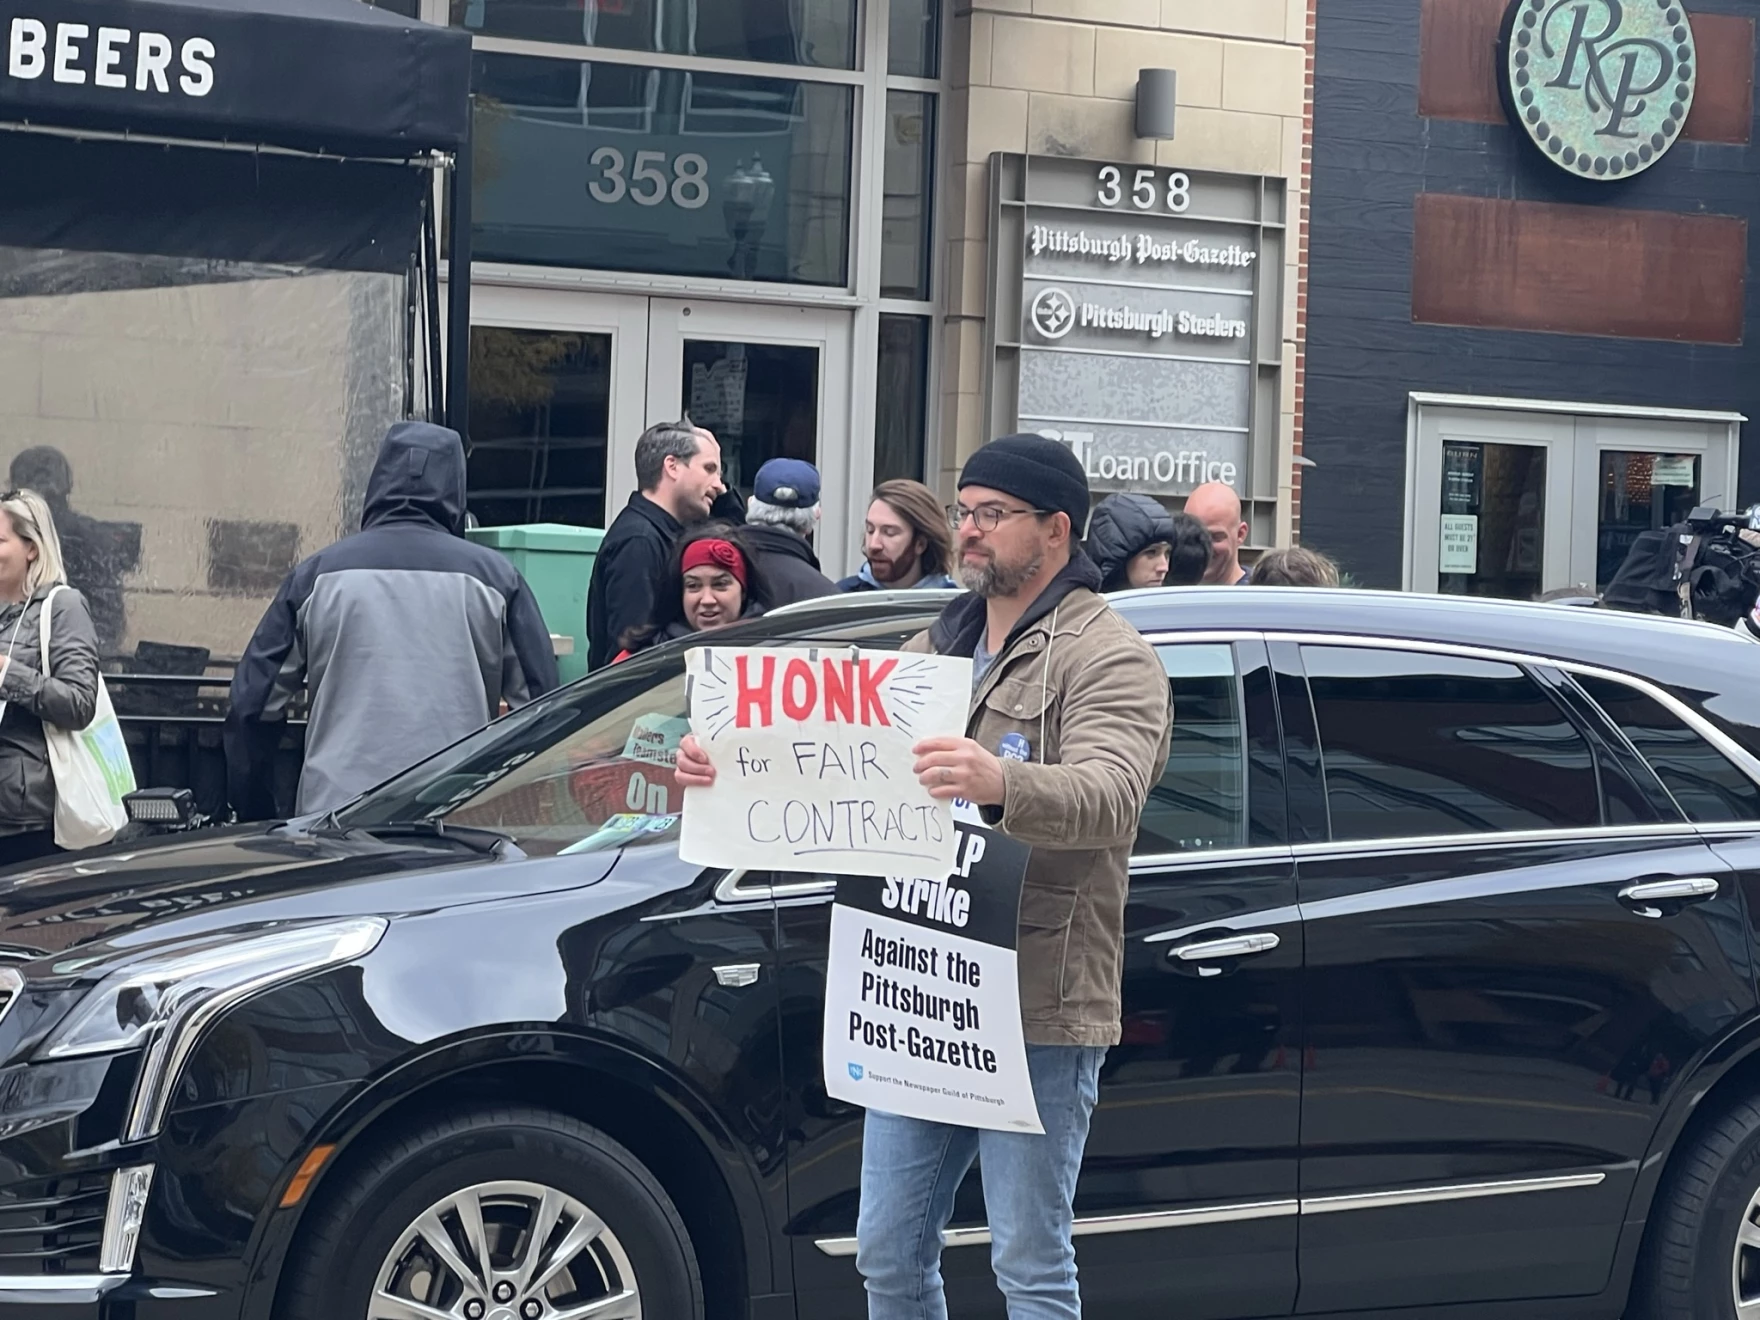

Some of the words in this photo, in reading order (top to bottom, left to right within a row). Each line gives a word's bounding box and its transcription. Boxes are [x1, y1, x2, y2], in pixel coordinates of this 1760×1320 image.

[8, 17, 216, 97] BEERS
[588, 146, 709, 209] 358
[1097, 165, 1191, 213] 358
[1031, 225, 1132, 262] Pittsburgh
[1081, 302, 1174, 338] Pittsburgh
[1177, 309, 1246, 338] Steelers
[1085, 447, 1150, 481] Loan
[1153, 451, 1237, 486] Office
[735, 655, 898, 728] HONK
[736, 747, 770, 777] for
[792, 741, 889, 780] FAIR
[626, 771, 668, 815] On
[748, 798, 943, 849] CONTRACTS
[881, 876, 971, 928] Strike
[861, 928, 938, 978] Against
[946, 951, 981, 988] the
[861, 971, 980, 1031] Pittsburgh
[849, 1010, 997, 1074] Post-Gazette
[868, 1071, 892, 1083] Support
[892, 1077, 903, 1086] the
[904, 1080, 941, 1094] Newspaper
[942, 1087, 960, 1098] Guild
[961, 1091, 969, 1099] of
[969, 1092, 1006, 1106] Pittsburgh
